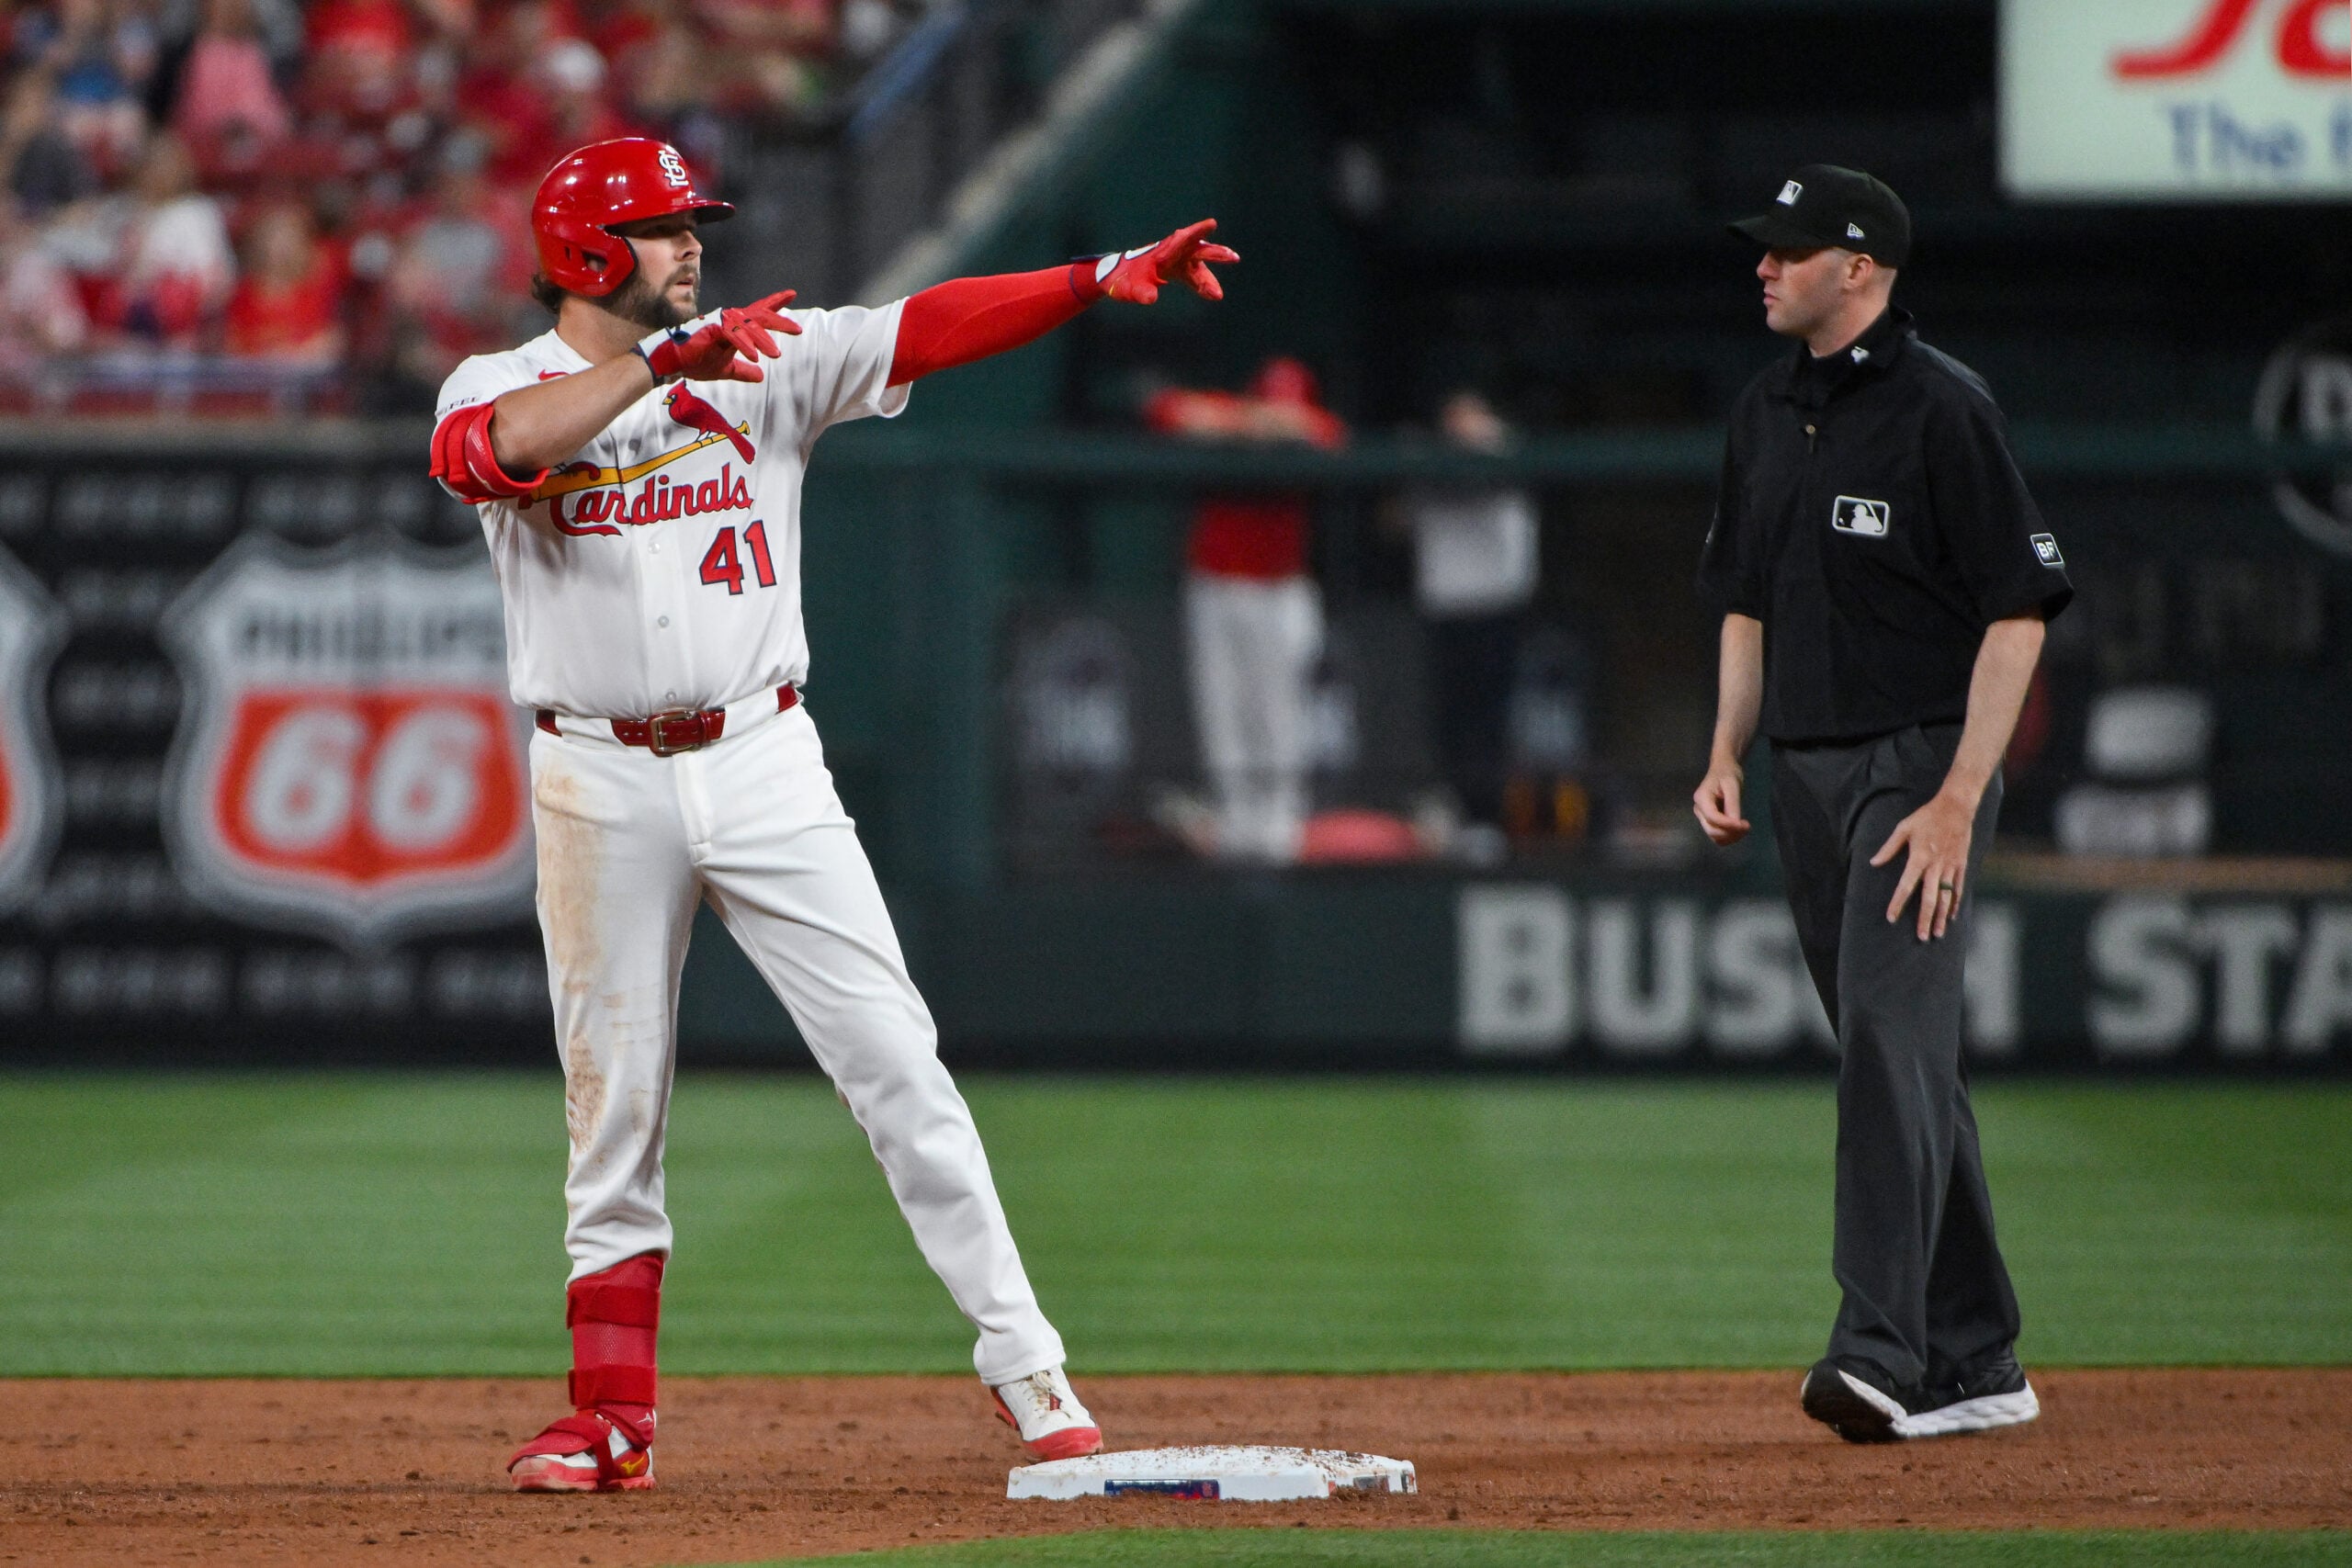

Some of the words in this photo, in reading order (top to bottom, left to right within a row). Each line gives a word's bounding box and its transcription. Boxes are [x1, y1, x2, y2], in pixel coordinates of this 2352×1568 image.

[551, 460, 754, 537] Cardinals
[699, 519, 777, 596] 41
[2036, 541, 2055, 559] BF
[248, 705, 485, 851] 66
[1459, 887, 2020, 1053] BUS
